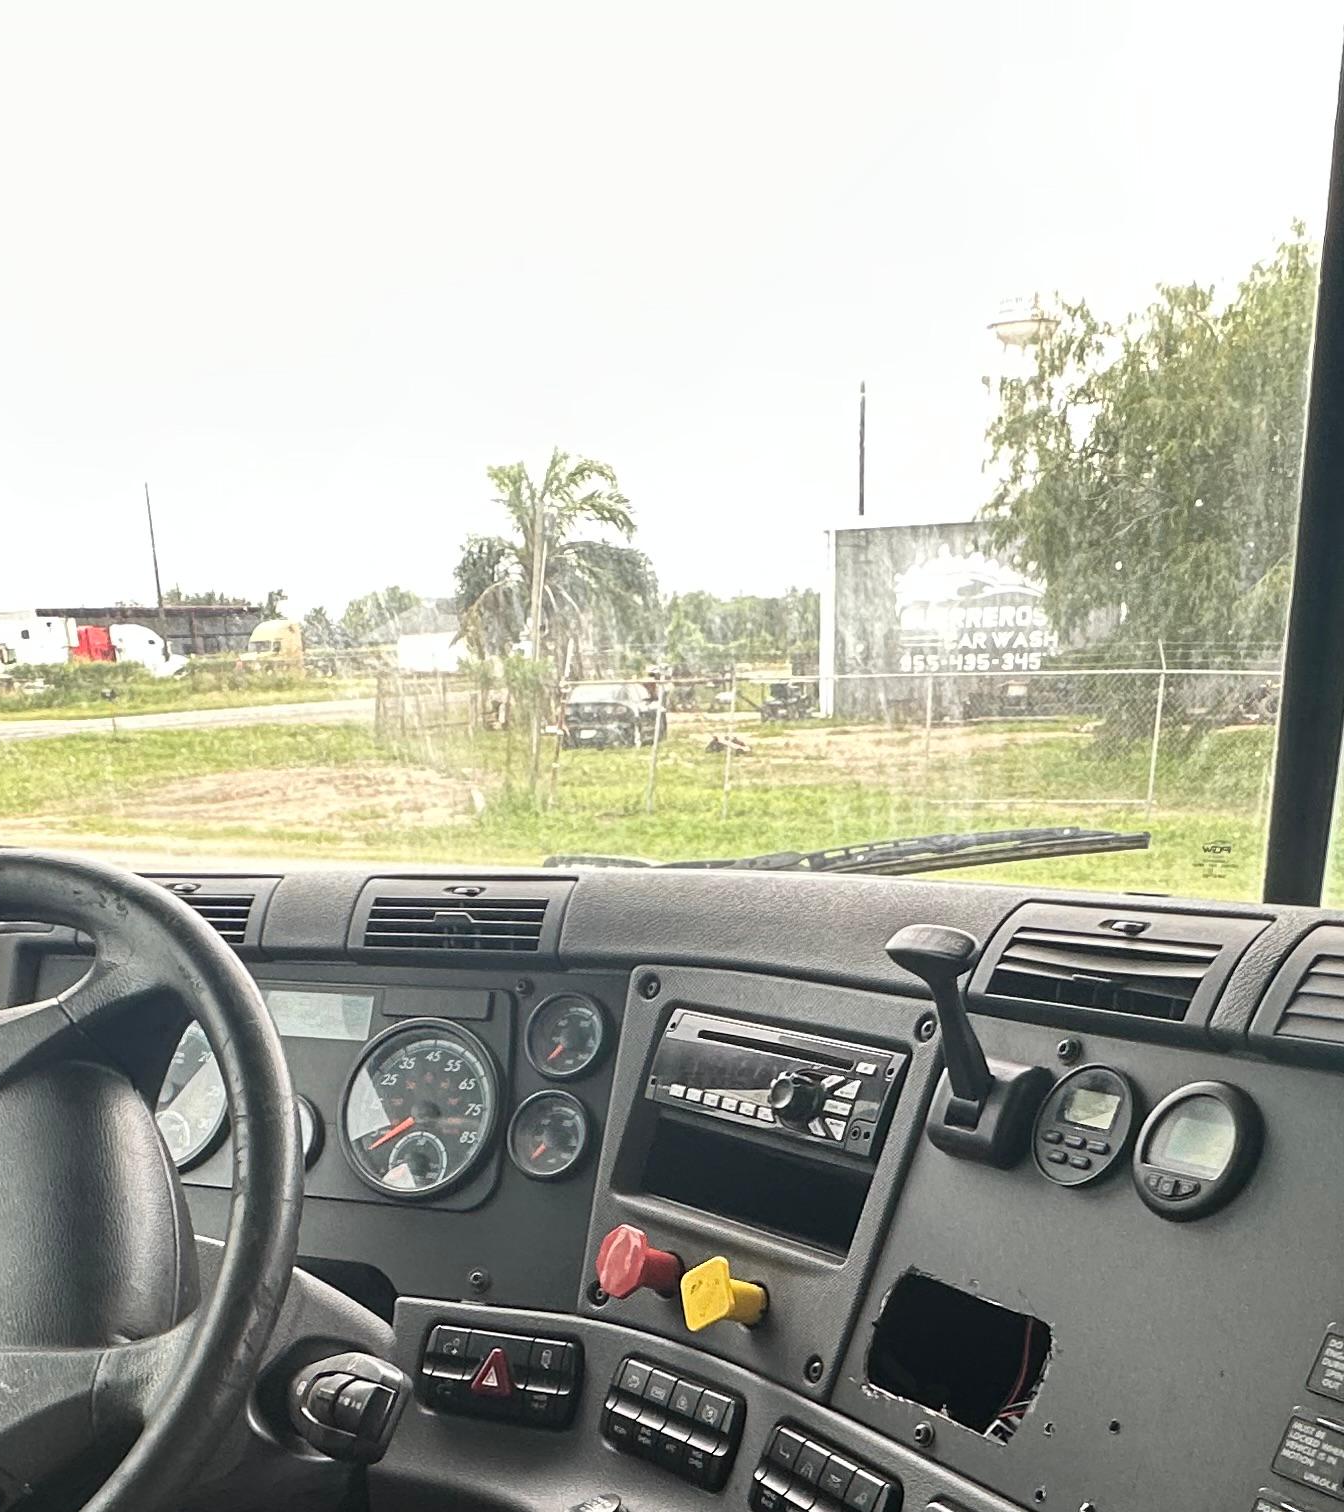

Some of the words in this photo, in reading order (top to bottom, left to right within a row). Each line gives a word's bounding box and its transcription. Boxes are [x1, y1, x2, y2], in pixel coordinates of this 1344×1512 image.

[991, 630, 1059, 649] WASH
[425, 1050, 441, 1062] 45
[399, 1057, 416, 1069] 35
[444, 1060, 462, 1071] 55
[381, 1074, 399, 1085] 25
[459, 1078, 476, 1090] 65
[465, 1104, 483, 1116] 75
[459, 1132, 476, 1144] 85
[1281, 1448, 1315, 1467] MOTION
[1303, 1472, 1338, 1491] UNLOCK
